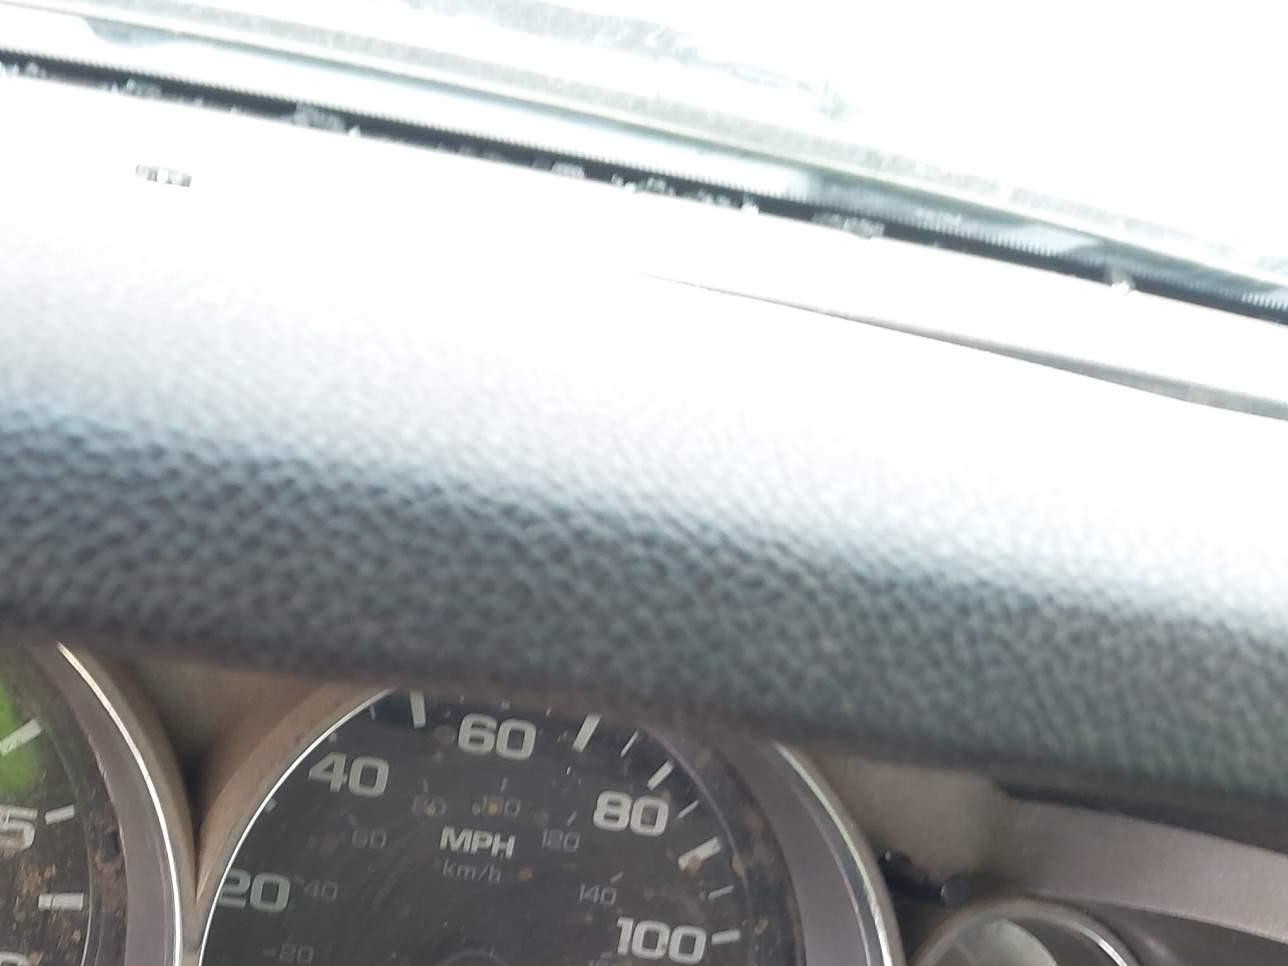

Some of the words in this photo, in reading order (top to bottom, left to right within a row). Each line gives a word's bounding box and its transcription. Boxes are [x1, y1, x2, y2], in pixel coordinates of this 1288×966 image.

[458, 715, 537, 761] 60
[308, 752, 389, 797] 40
[592, 790, 669, 837] 80
[440, 826, 516, 859] MPH
[541, 828, 580, 852] 120
[217, 868, 290, 912] 20
[443, 859, 502, 885] km/h
[304, 880, 338, 903] 40
[579, 884, 617, 905] 140
[616, 918, 708, 965] 100
